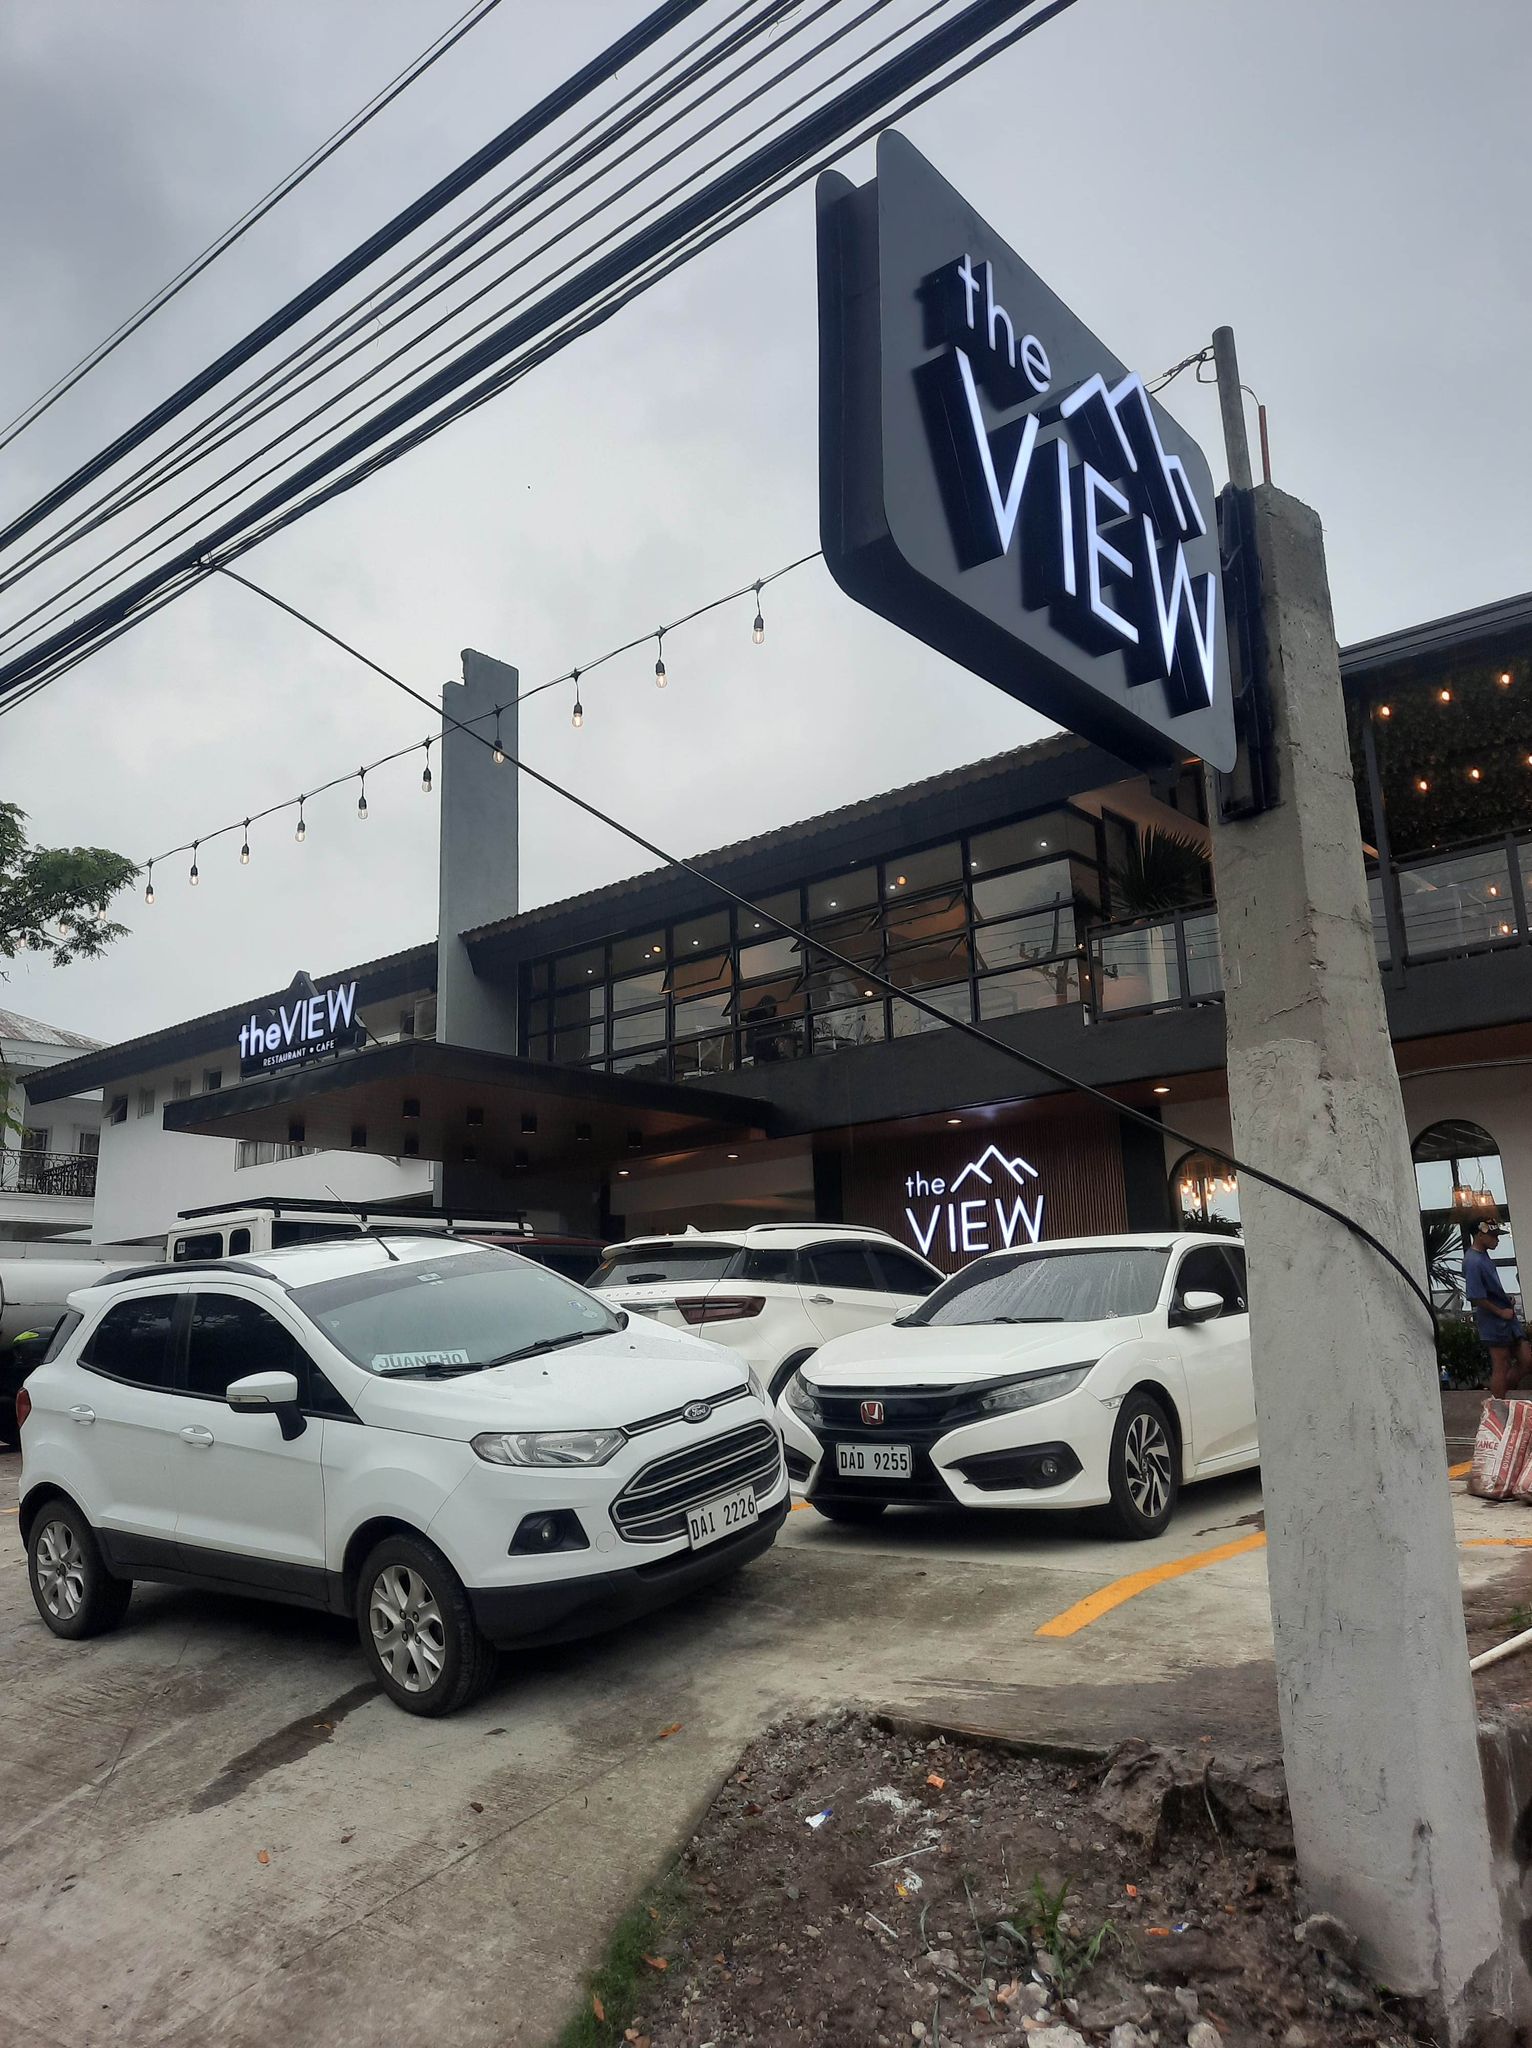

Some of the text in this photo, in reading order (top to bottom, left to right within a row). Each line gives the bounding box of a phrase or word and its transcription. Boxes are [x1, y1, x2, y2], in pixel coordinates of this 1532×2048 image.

[957, 252, 1052, 393] the
[955, 345, 1217, 707] VIEW
[262, 1039, 335, 1067] RESTAURANT CAFE
[905, 1170, 946, 1198] the
[905, 1194, 1045, 1257] VIEW
[378, 1352, 464, 1368] JUANCHO
[840, 1451, 908, 1471] DAD 9255
[690, 1494, 755, 1541] DAI 2226
